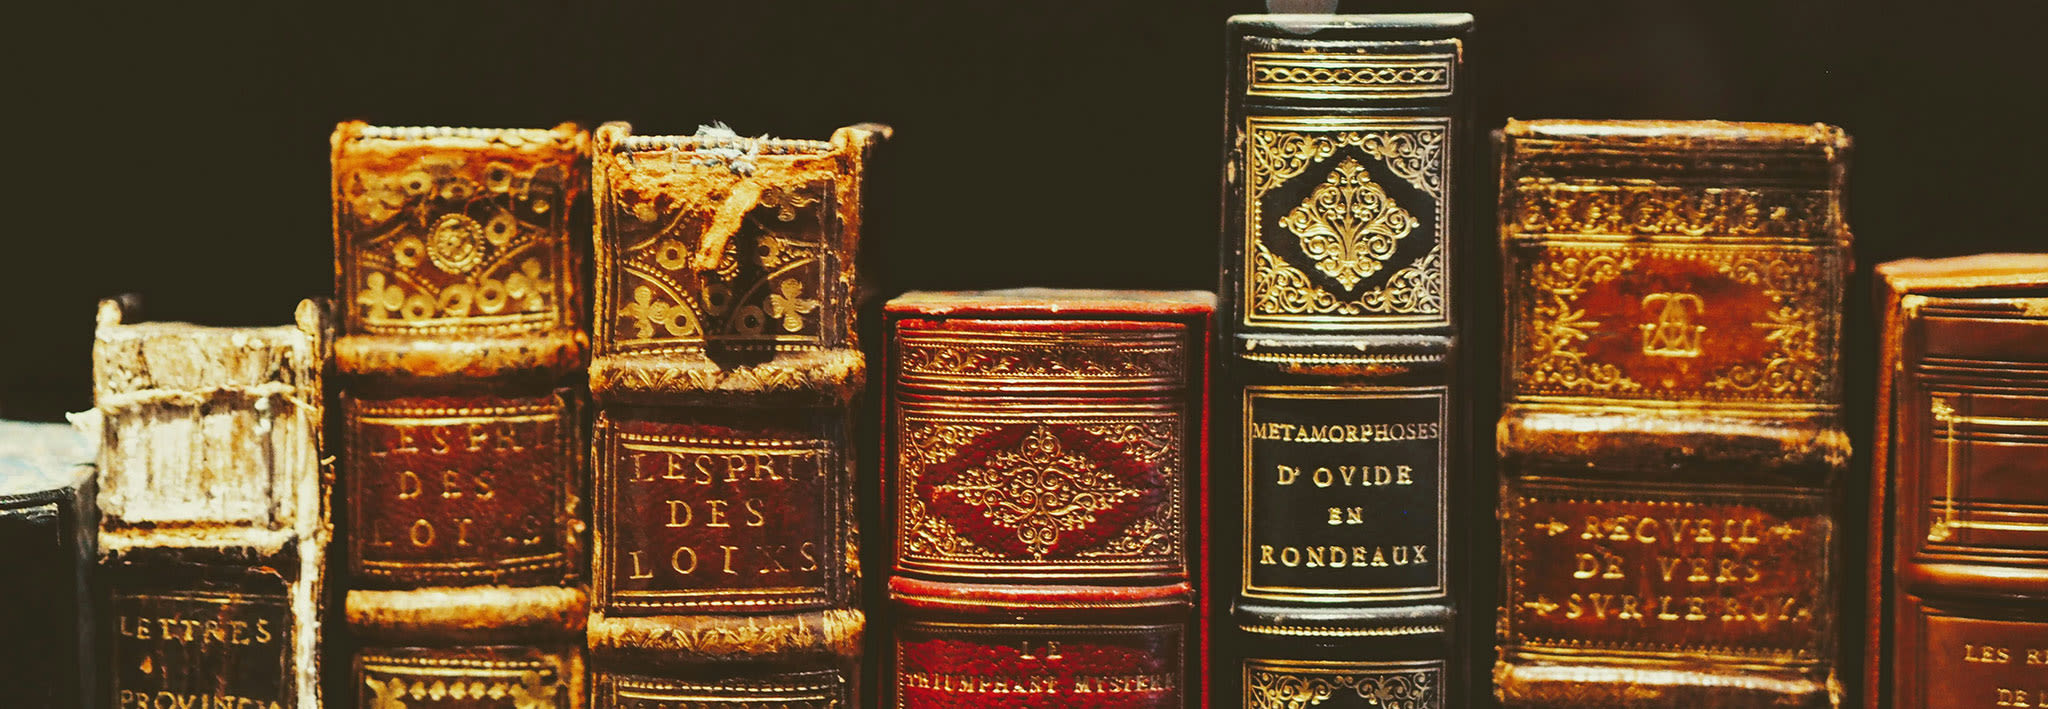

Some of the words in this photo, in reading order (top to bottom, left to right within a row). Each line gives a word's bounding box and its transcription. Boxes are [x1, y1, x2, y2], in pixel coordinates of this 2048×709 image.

[1252, 422, 1440, 444] METAMORPHOSES
[399, 471, 495, 500] DES
[1277, 464, 1301, 486] D'
[1312, 465, 1414, 488] OVIDE
[665, 499, 765, 528] DES
[1327, 506, 1364, 525] EN
[369, 516, 542, 548] LOIS
[1580, 515, 1758, 544] RECVEIL
[628, 542, 819, 580] LOIXS
[1260, 545, 1428, 568] RONDEAUX
[1574, 552, 1625, 580] DE
[1657, 556, 1761, 582] VERS
[1566, 593, 1643, 621] SVR
[1657, 595, 1707, 621] LE
[120, 615, 273, 646] LETTRES
[1020, 641, 1063, 661] LE
[1964, 643, 2011, 664] LES
[2026, 648, 2048, 665] R
[1996, 688, 2030, 707] DE
